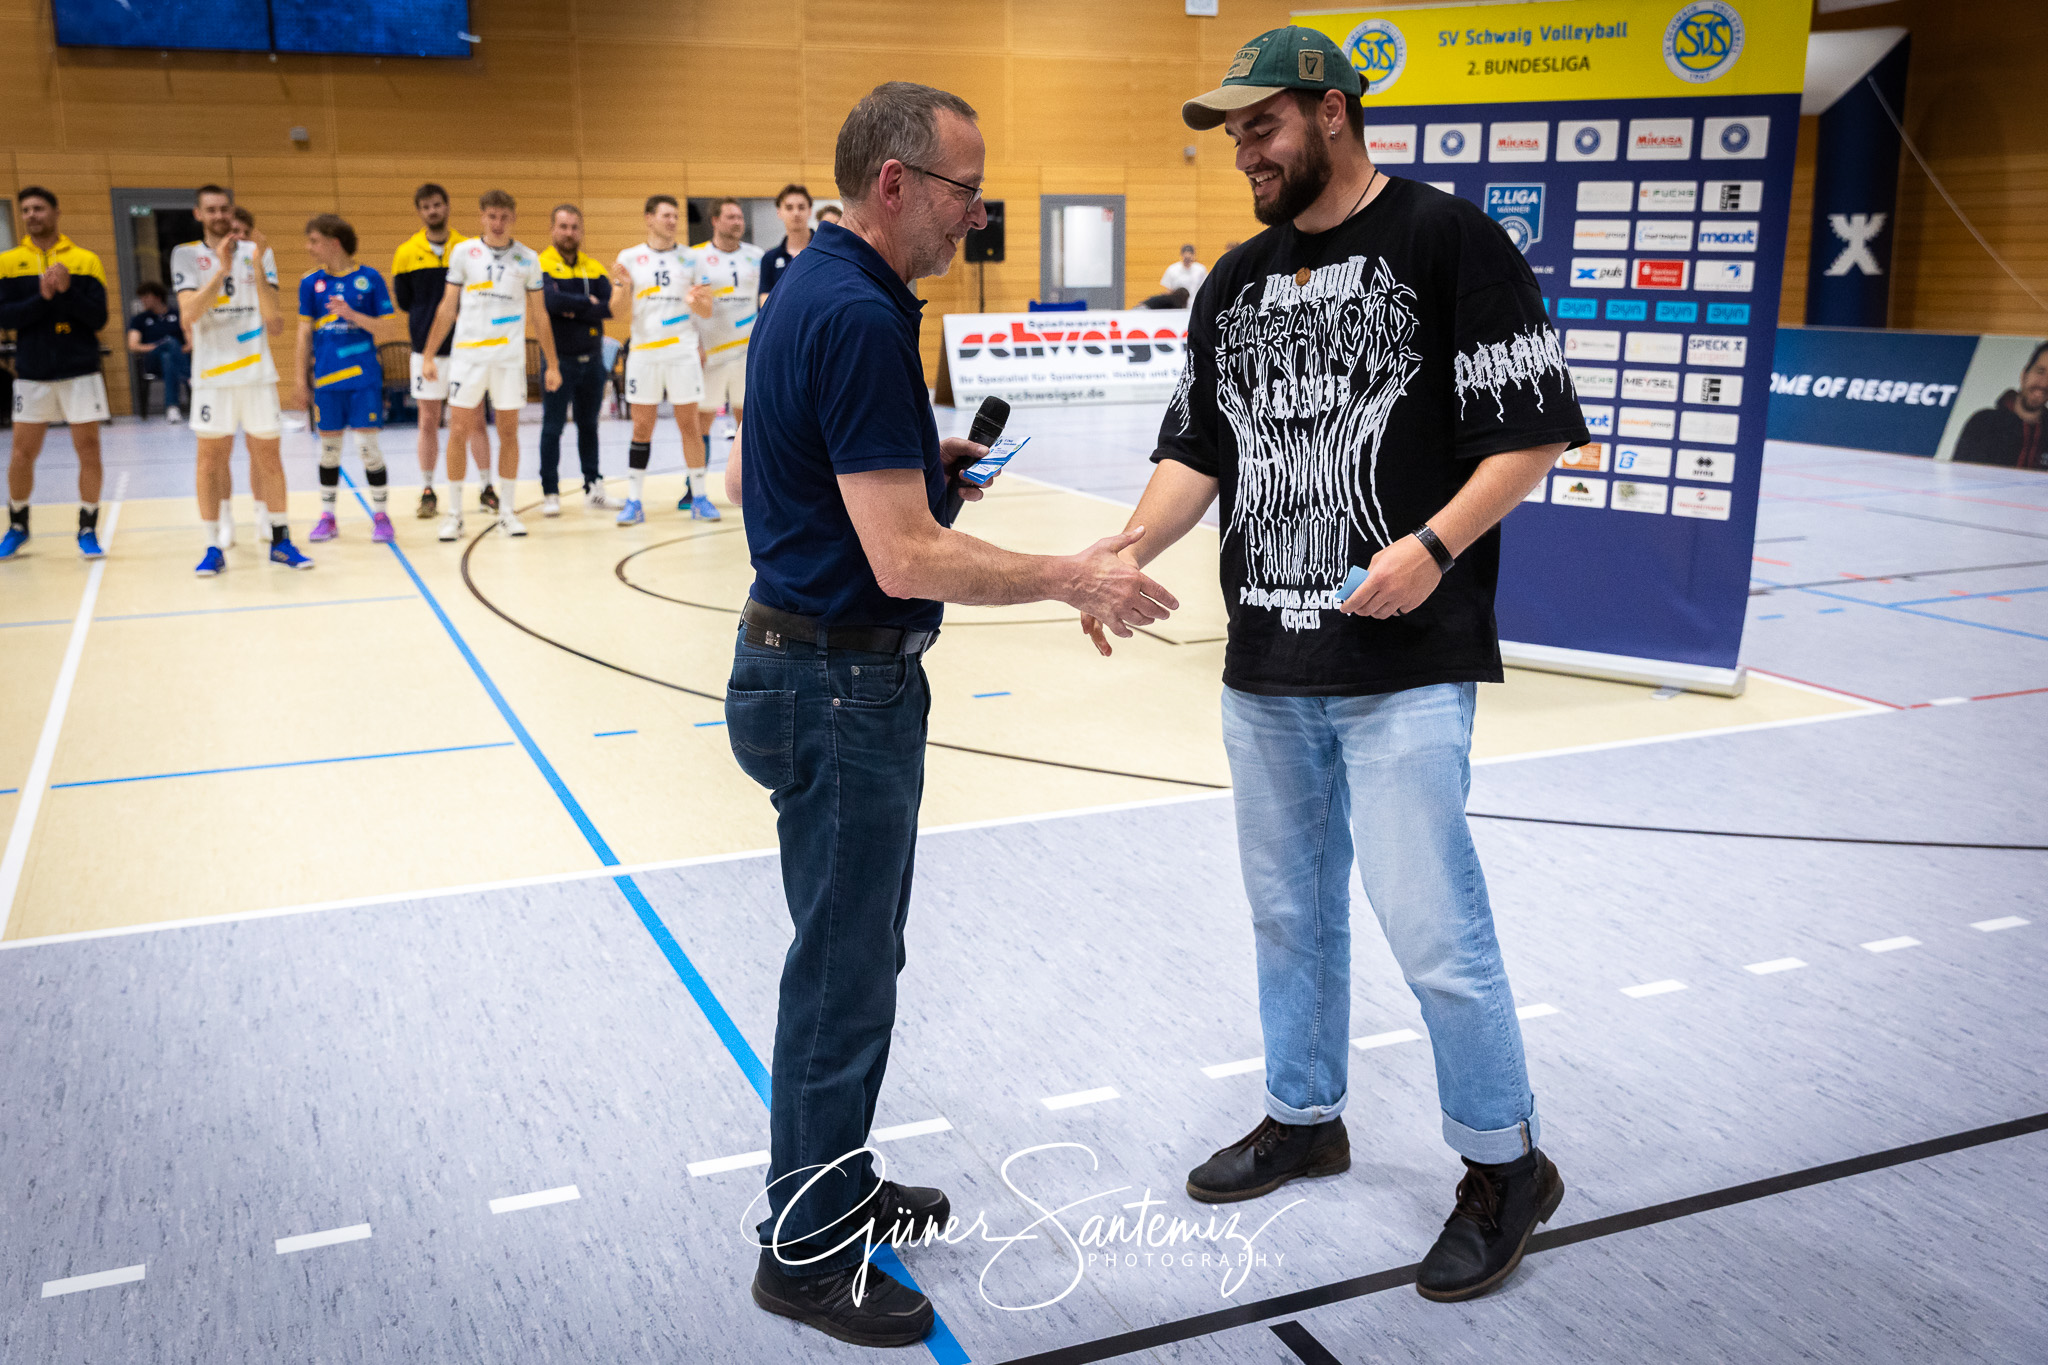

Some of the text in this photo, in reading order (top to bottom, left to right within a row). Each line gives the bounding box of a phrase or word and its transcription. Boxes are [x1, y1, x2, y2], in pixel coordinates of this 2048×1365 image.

[1438, 21, 1628, 47] SV Schwaig Volleyball
[1467, 55, 1591, 76] 2. BUNDESLIGA
[487, 264, 505, 282] 17
[653, 271, 671, 287] 15
[732, 271, 739, 288] 1
[223, 275, 236, 297] 6
[1689, 339, 1730, 352] SPECK
[1623, 376, 1675, 391] MEYSEL
[1812, 376, 1848, 398] OF
[1846, 377, 1959, 407] RESPECT
[201, 404, 212, 422] 6
